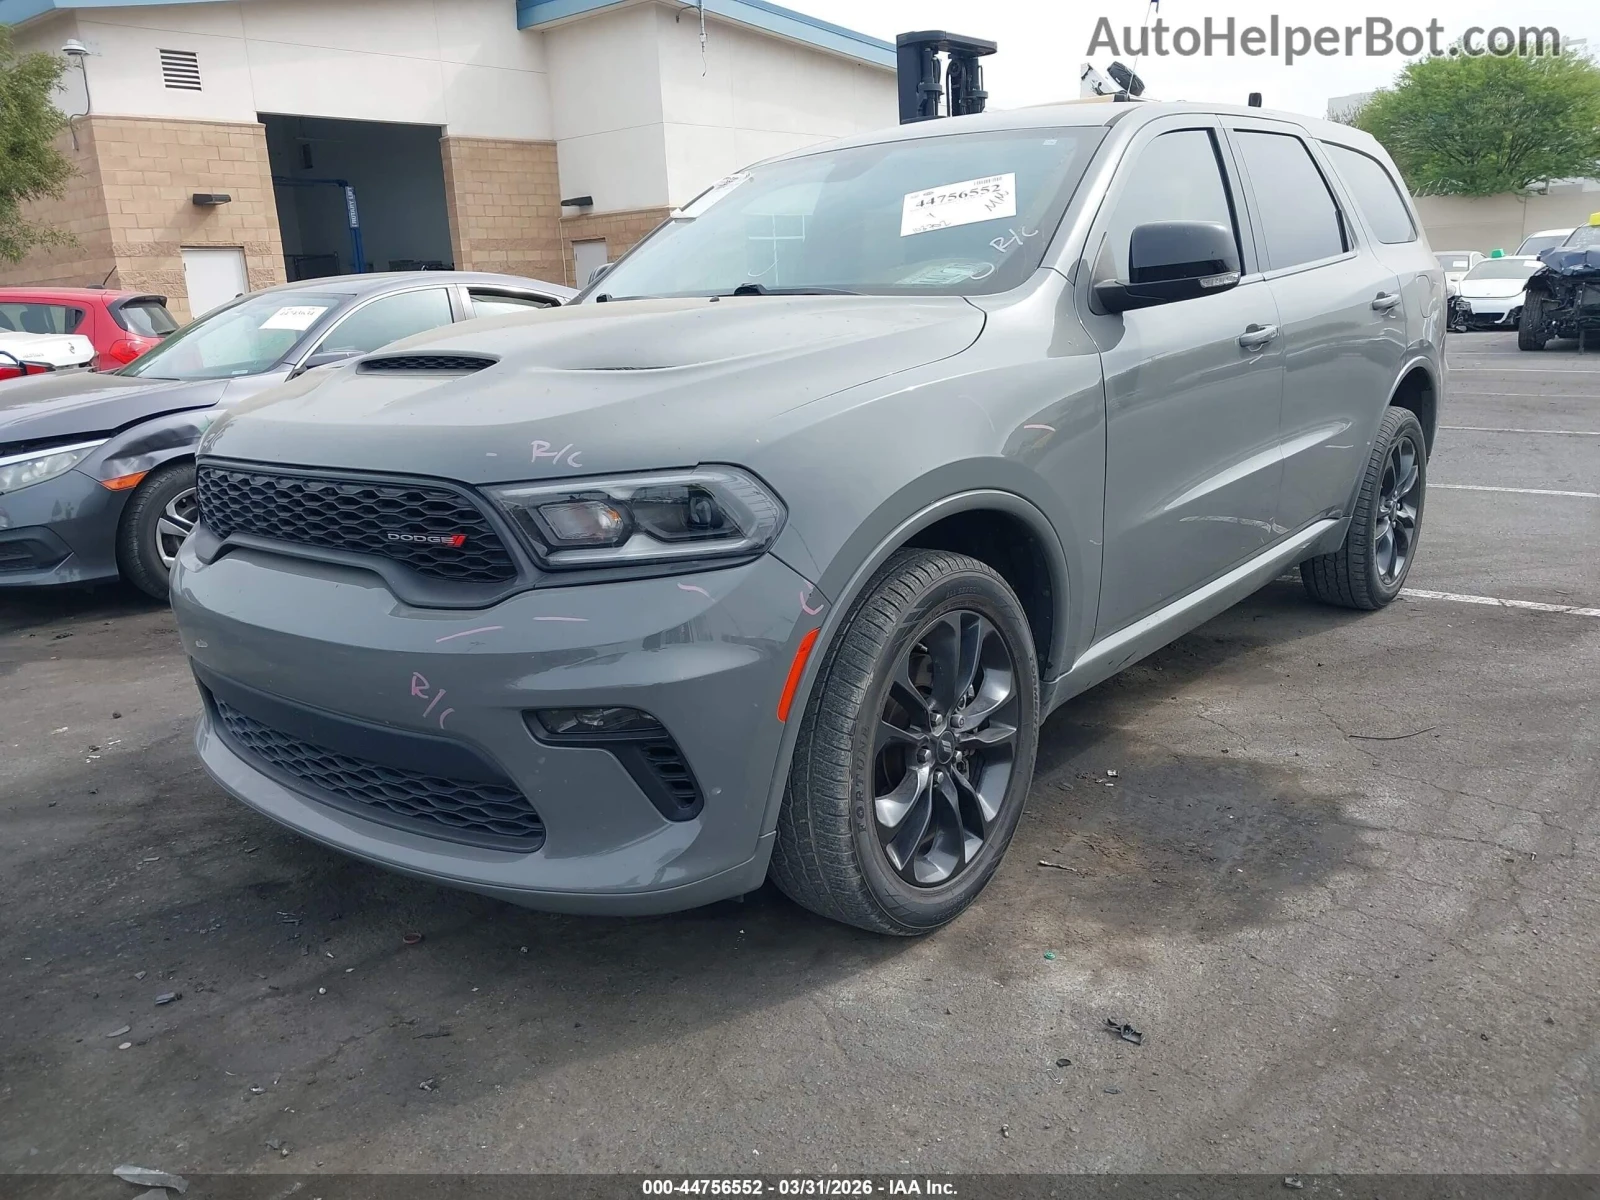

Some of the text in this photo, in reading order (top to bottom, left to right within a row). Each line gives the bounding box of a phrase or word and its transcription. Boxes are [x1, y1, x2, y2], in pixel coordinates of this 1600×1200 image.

[916, 184, 1002, 208] 44756552
[531, 440, 583, 468] R/C
[387, 533, 455, 544] DODGE
[411, 671, 455, 730] R/C
[856, 726, 870, 833] FORTUNE
